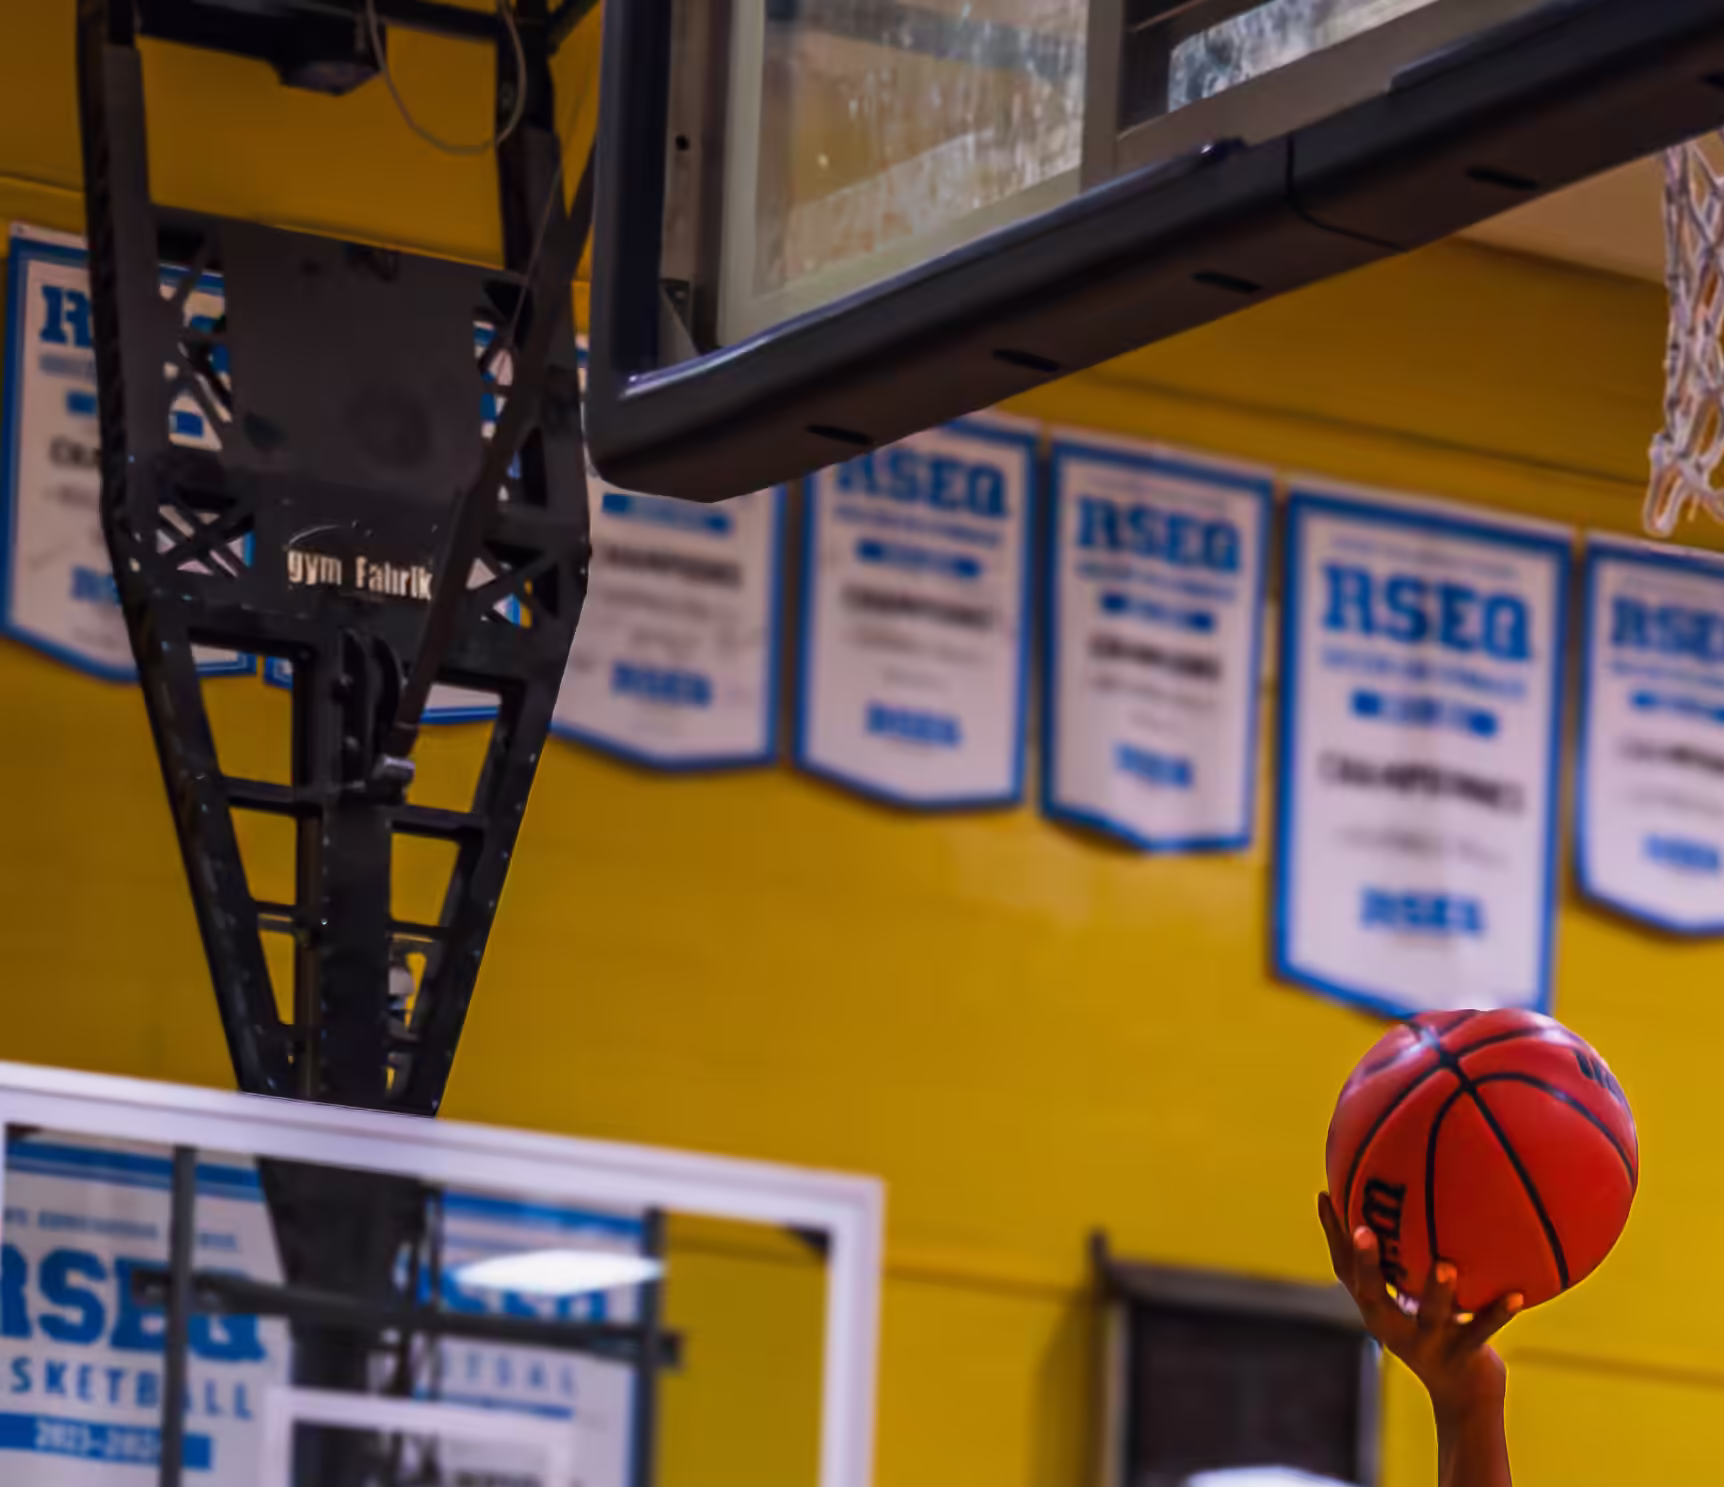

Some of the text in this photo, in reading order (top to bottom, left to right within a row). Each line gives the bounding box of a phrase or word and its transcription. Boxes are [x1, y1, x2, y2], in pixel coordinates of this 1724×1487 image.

[286, 550, 342, 586] gym
[1077, 495, 1241, 575] RSEQ
[1321, 562, 1533, 663] RSEQ
